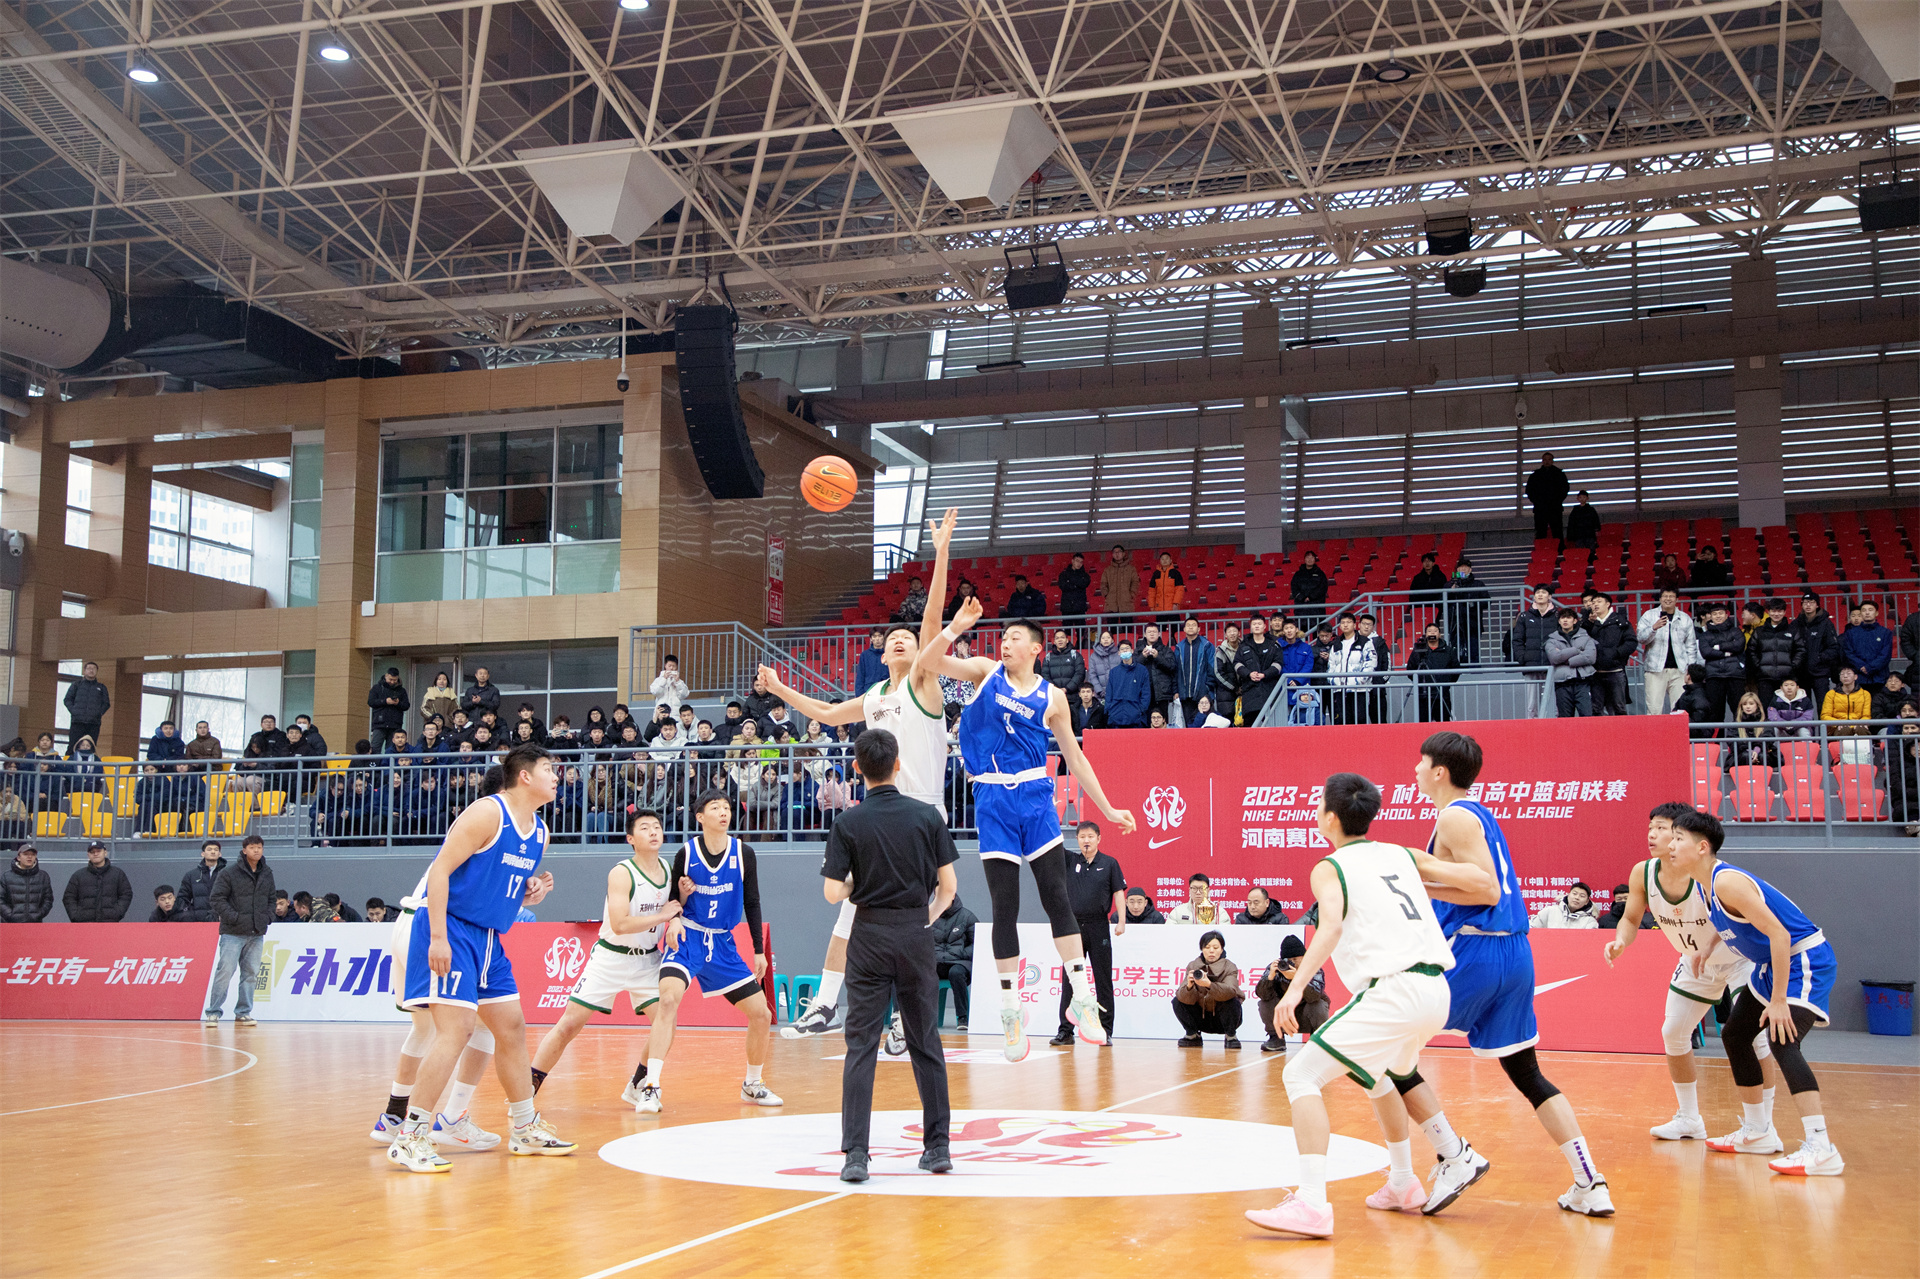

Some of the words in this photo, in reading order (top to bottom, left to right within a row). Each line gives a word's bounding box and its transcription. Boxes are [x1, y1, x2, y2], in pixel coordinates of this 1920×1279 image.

[812, 482, 842, 501] ELITE
[1003, 712, 1015, 734] 3
[1390, 780, 1629, 805] 耐国高中篮球联赛
[1241, 810, 1275, 822] NIKE
[1278, 809, 1318, 822] CHINA
[1372, 808, 1415, 822] CHOOL
[1516, 806, 1576, 819] LEAGUE
[1241, 828, 1330, 849] 河南赛区
[506, 874, 523, 898] 17
[1380, 874, 1422, 920] 5
[708, 900, 718, 919] 2
[1678, 933, 1698, 951] 14
[441, 970, 462, 996] 17
[537, 994, 571, 1008] CHB
[1018, 992, 1039, 1003] SC
[1142, 988, 1176, 998] SPOR
